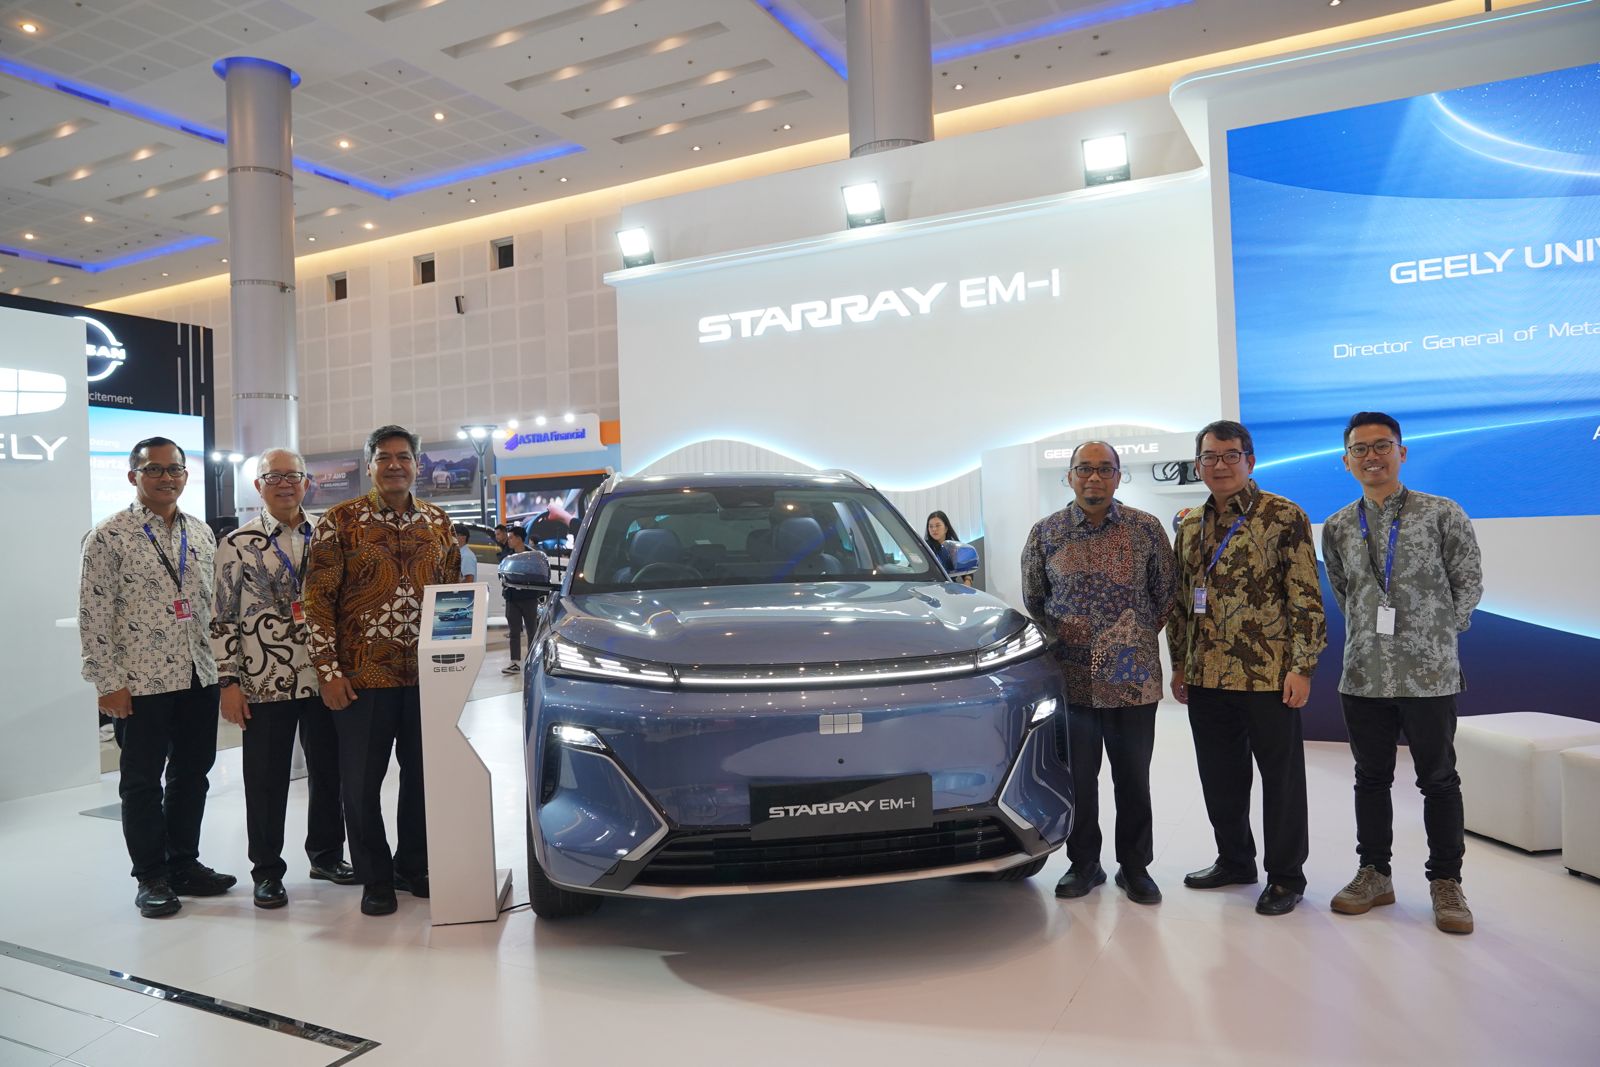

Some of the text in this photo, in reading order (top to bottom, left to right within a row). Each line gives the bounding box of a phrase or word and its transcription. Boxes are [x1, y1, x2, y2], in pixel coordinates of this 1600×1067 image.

[1389, 237, 1600, 284] GEELY UNI
[698, 282, 948, 343] STARRAY
[1333, 339, 1412, 359] Director
[1423, 329, 1503, 350] General
[1514, 325, 1539, 342] of
[88, 391, 134, 404] citement
[0, 433, 68, 461] LY
[519, 428, 586, 445] ASTRA Financial
[768, 797, 915, 818] STARRAY EM-i
